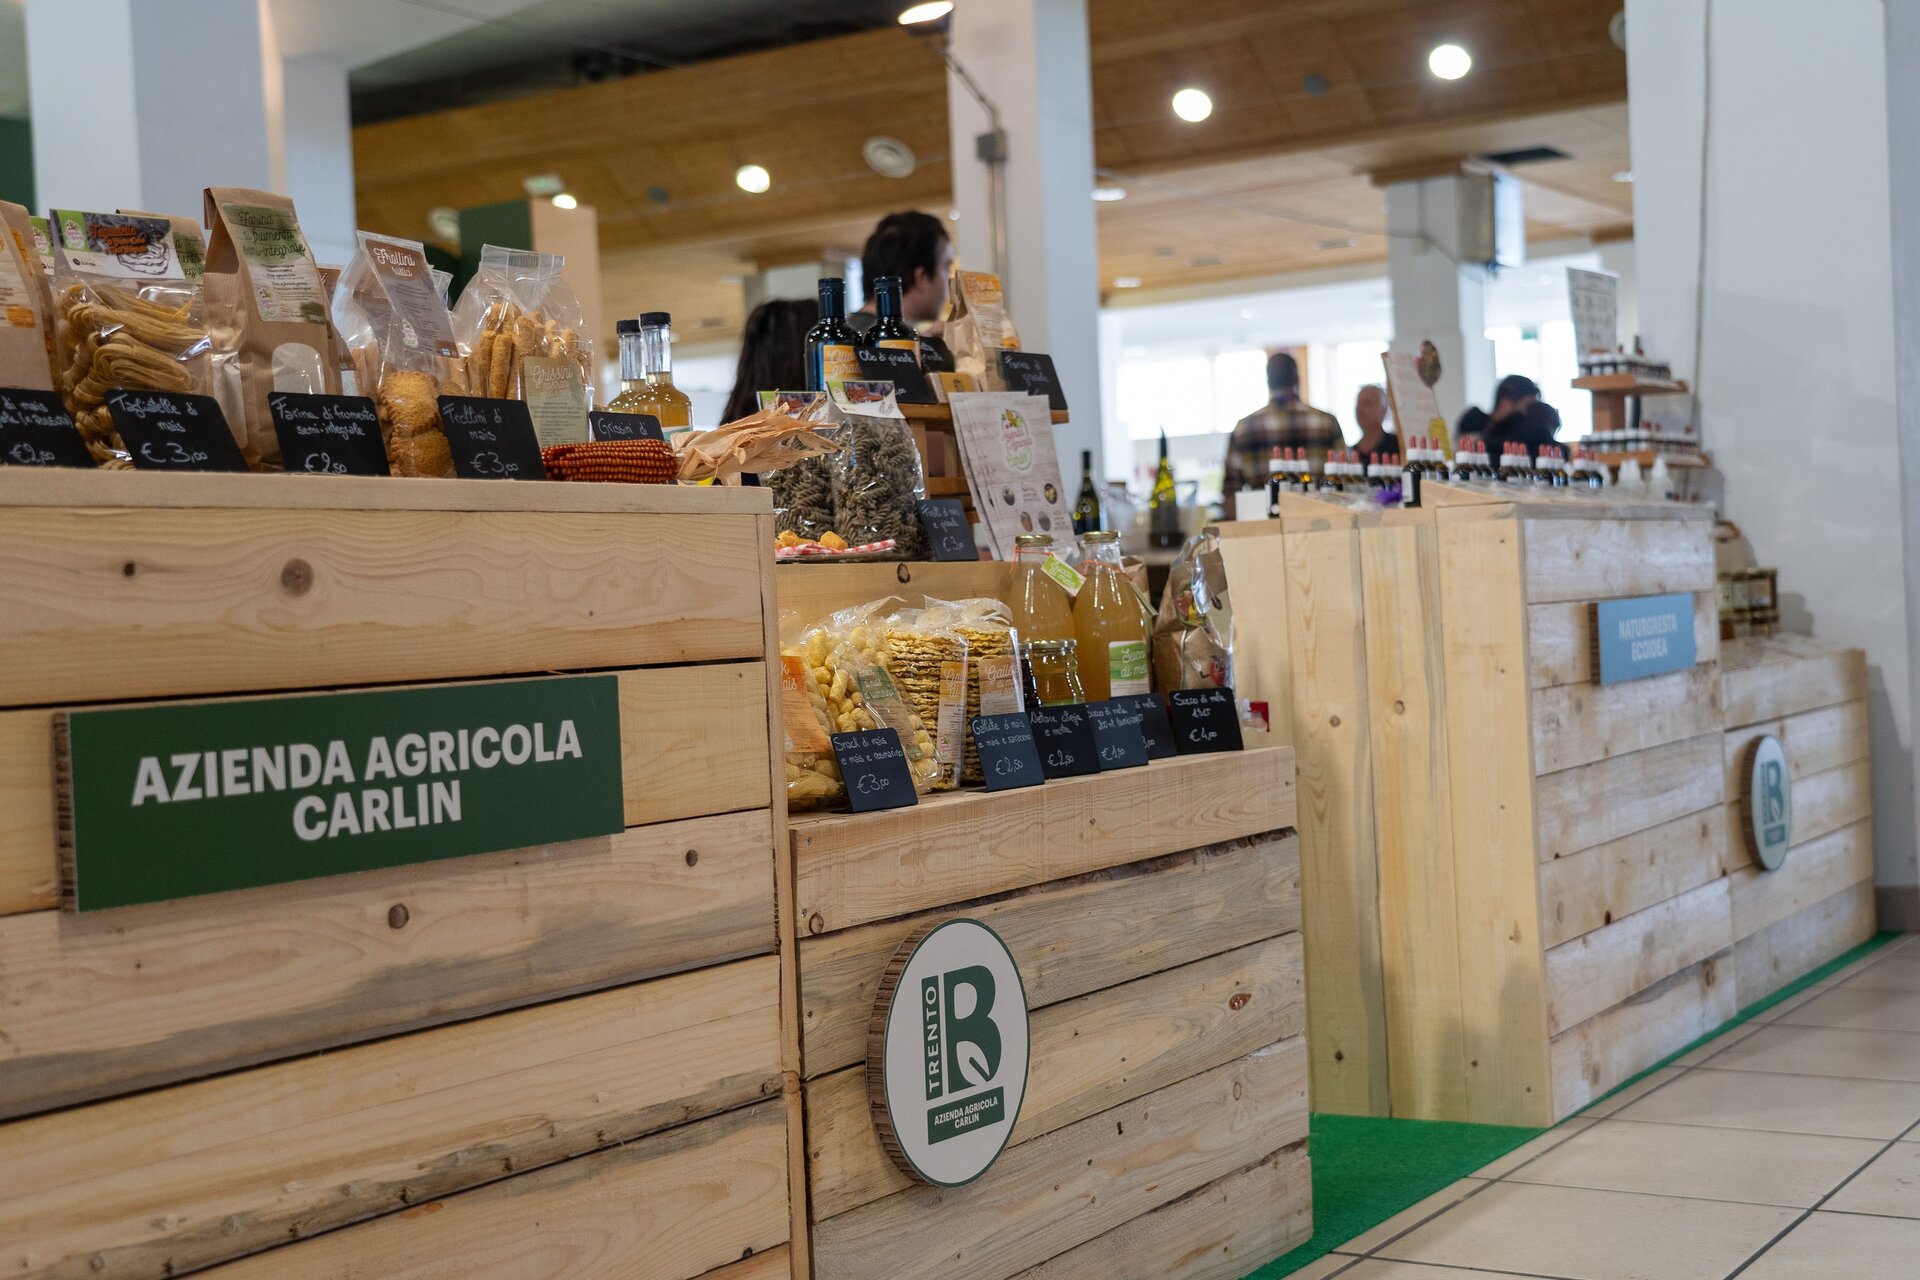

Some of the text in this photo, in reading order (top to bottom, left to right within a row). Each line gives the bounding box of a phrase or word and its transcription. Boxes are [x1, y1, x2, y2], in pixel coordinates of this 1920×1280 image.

[530, 362, 573, 389] Grissini
[110, 393, 199, 419] Tagliatelle di
[271, 396, 377, 422] Farina di frumento
[494, 408, 503, 424] di
[157, 420, 187, 433] mais
[469, 428, 497, 441] mais
[598, 417, 634, 439] Grissini
[640, 421, 648, 437] di
[833, 735, 888, 751] Snack di mais
[131, 719, 584, 807] AZIENDA AGRICOLA
[841, 758, 848, 766] e
[849, 753, 865, 763] mais
[856, 774, 889, 794] €3,00
[292, 780, 463, 842] CARLIN
[925, 985, 942, 1094] TRENTO
[934, 1096, 998, 1126] AZIENDA AGRICOLA
[954, 1112, 980, 1129] CARLIN
